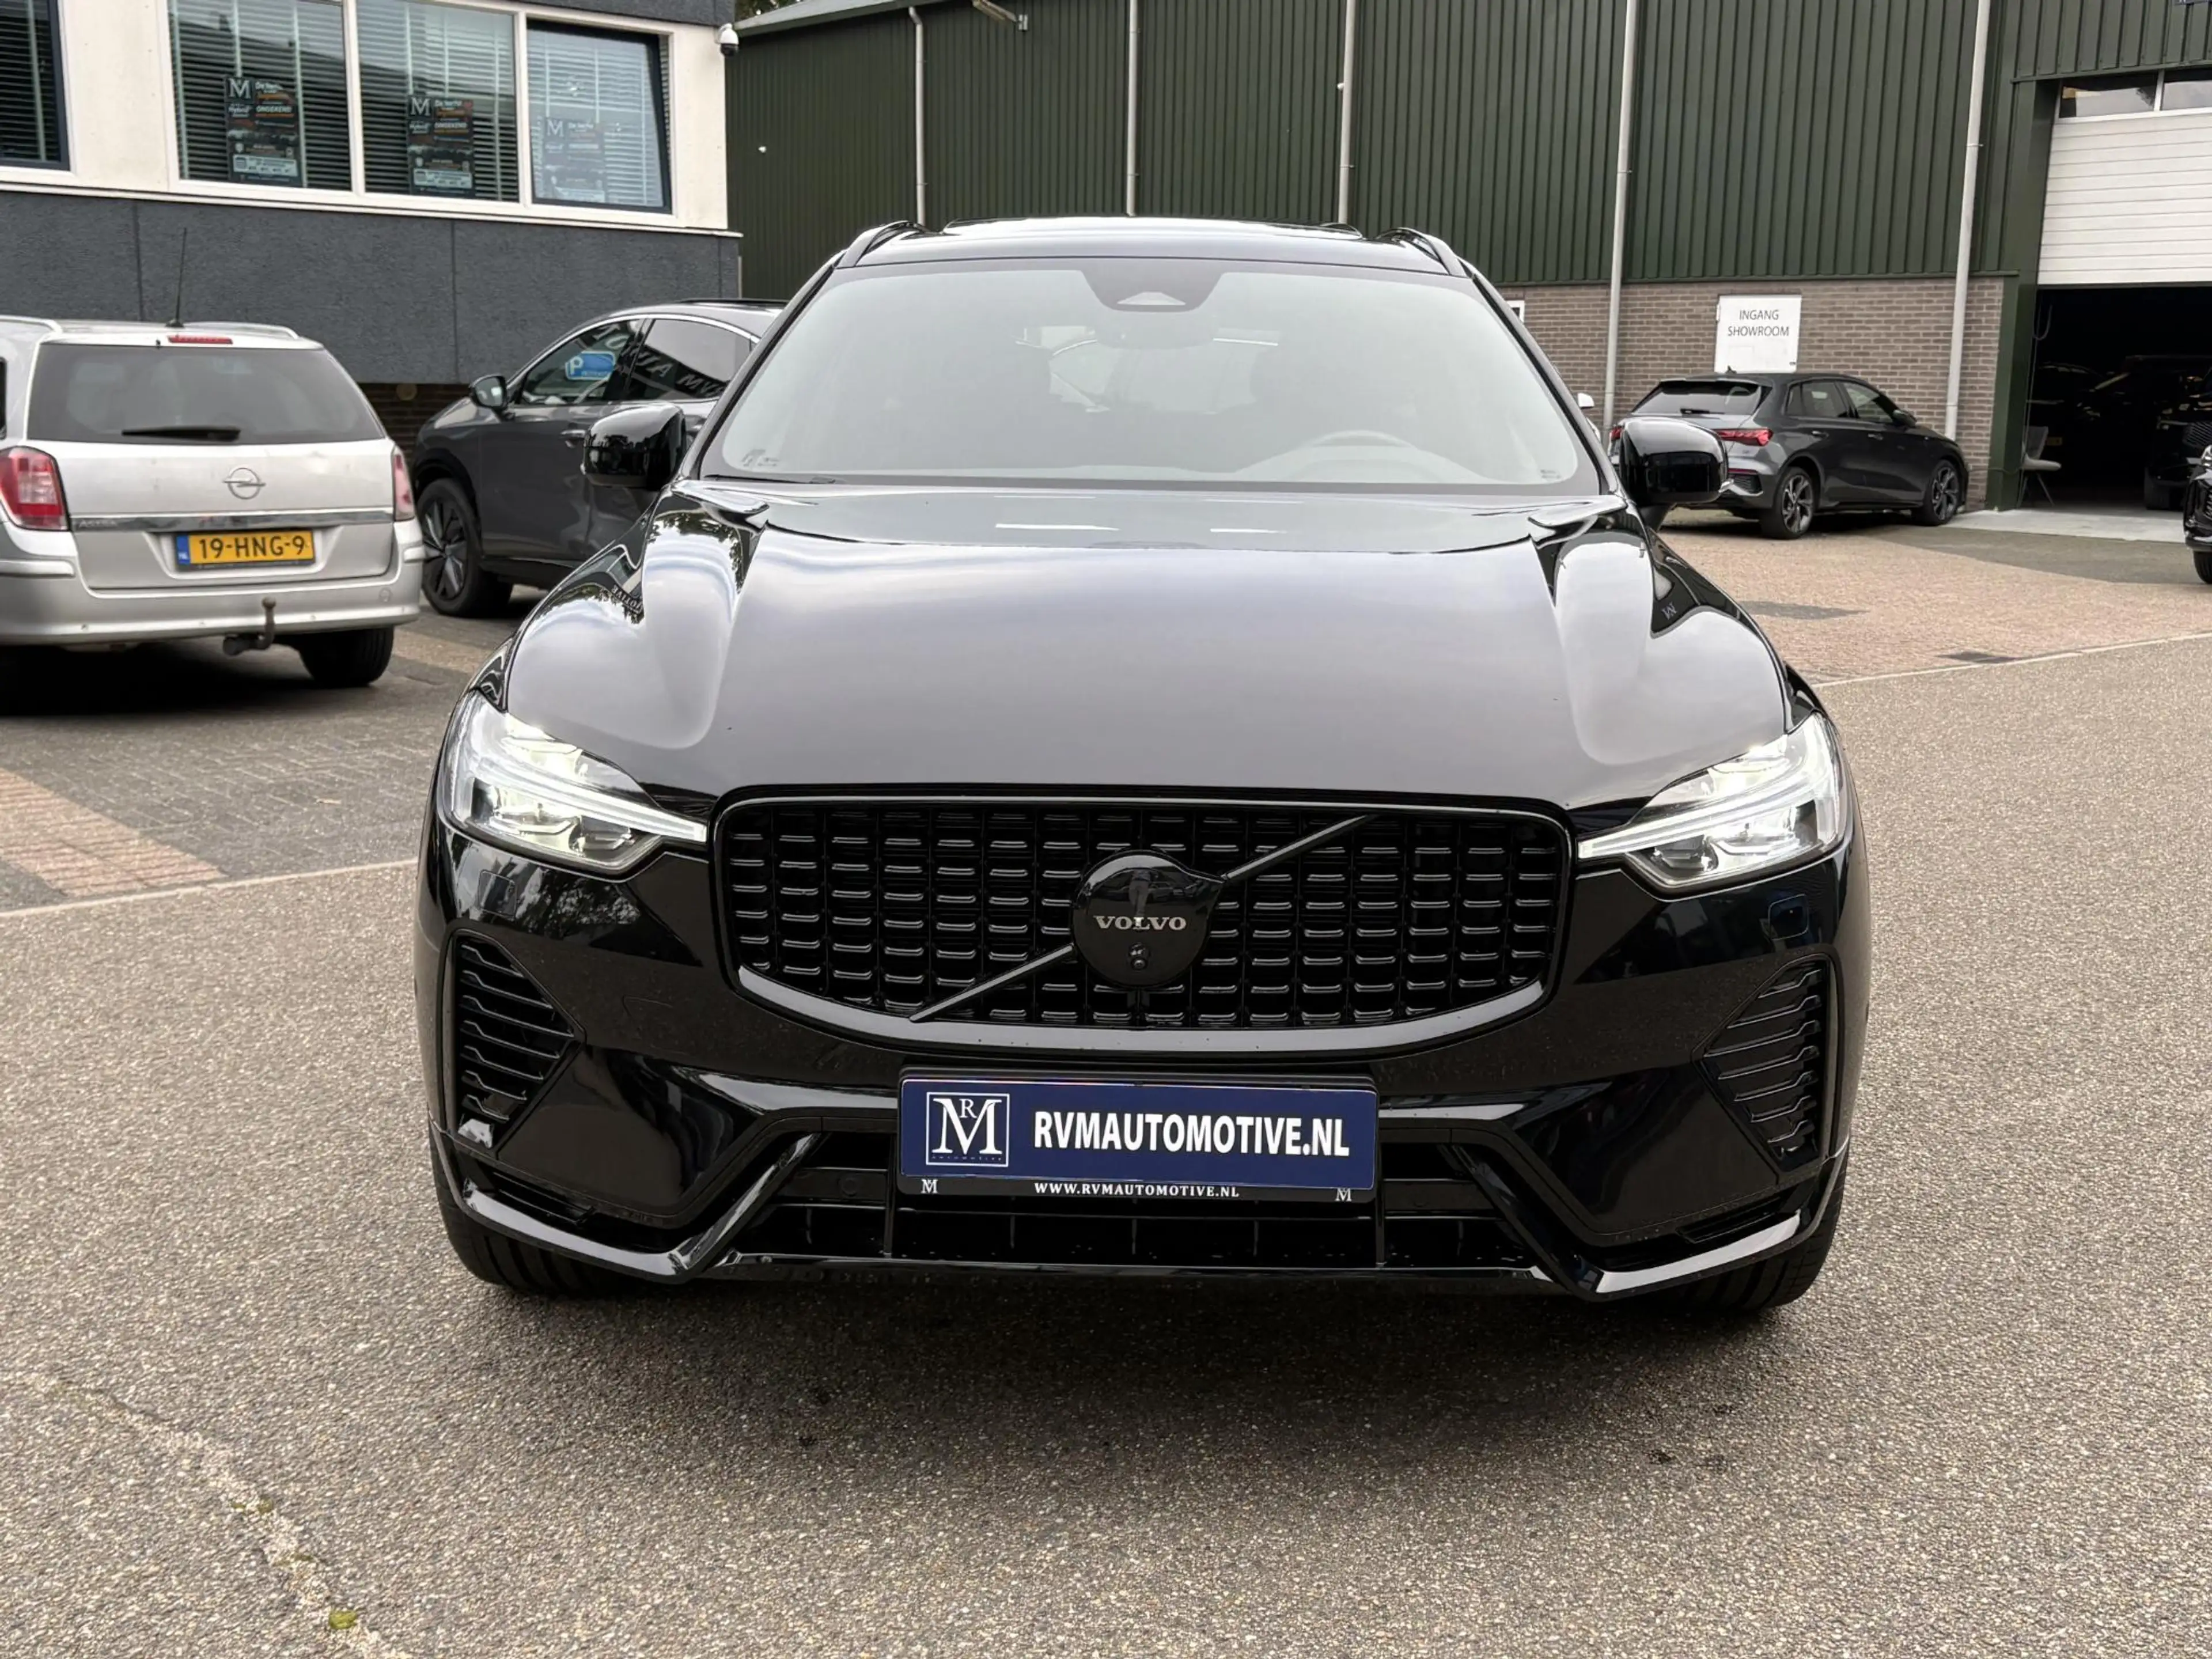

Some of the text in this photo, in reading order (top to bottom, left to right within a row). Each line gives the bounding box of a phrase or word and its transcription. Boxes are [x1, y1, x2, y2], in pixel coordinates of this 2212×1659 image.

[1739, 309, 1779, 320] INGANG
[1728, 325, 1790, 336] SHOWROOM
[199, 535, 305, 559] 19-HNG-9
[1094, 915, 1187, 930] VOLVO
[1034, 1111, 1350, 1157] RVMAUTOMOTIVE.NL
[1034, 1182, 1240, 1198] WWW.RVMAUTOMOTIVE.NL
